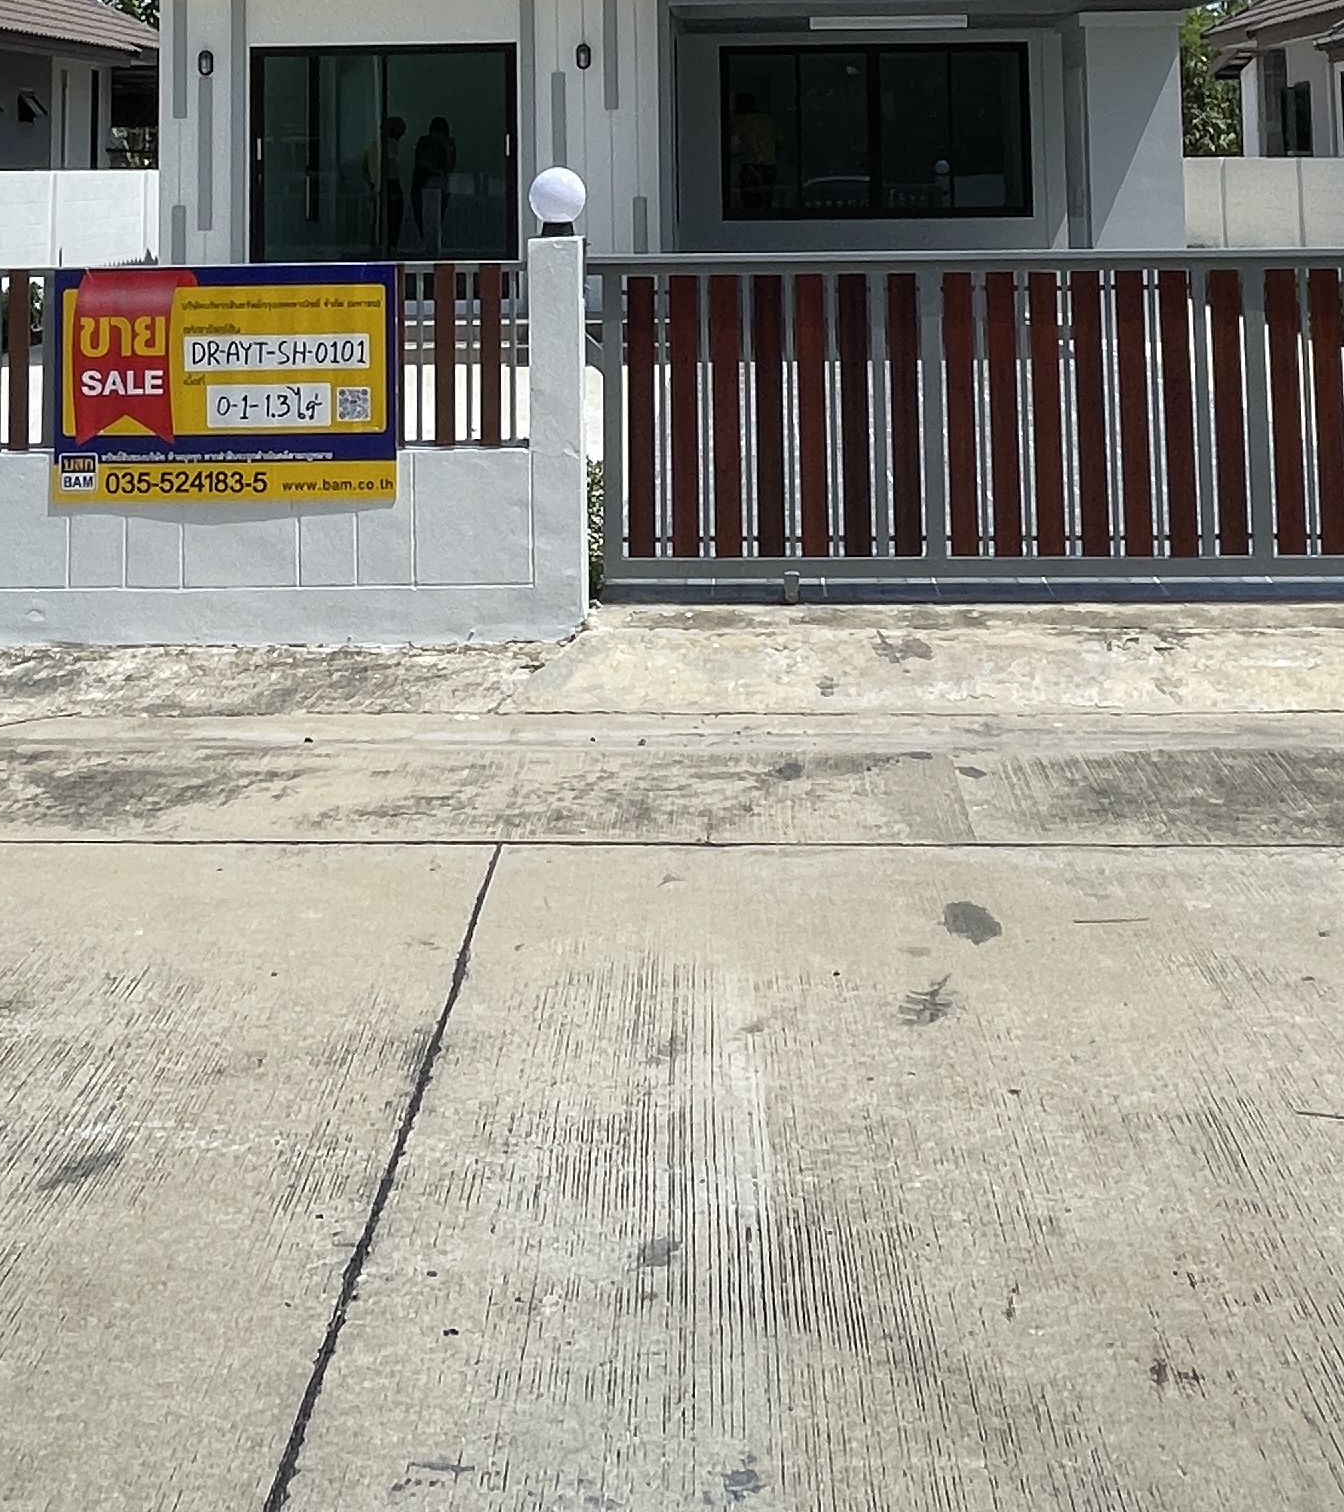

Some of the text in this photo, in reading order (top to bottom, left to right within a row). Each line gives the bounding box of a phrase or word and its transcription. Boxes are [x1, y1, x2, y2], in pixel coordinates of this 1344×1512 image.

[80, 316, 166, 358] ขาย
[191, 340, 367, 366] DR-AYT-SH-0101
[81, 370, 164, 396] SALE
[63, 475, 94, 488] BAM
[105, 471, 393, 494] 035-524183-5 www.bam.co.th
